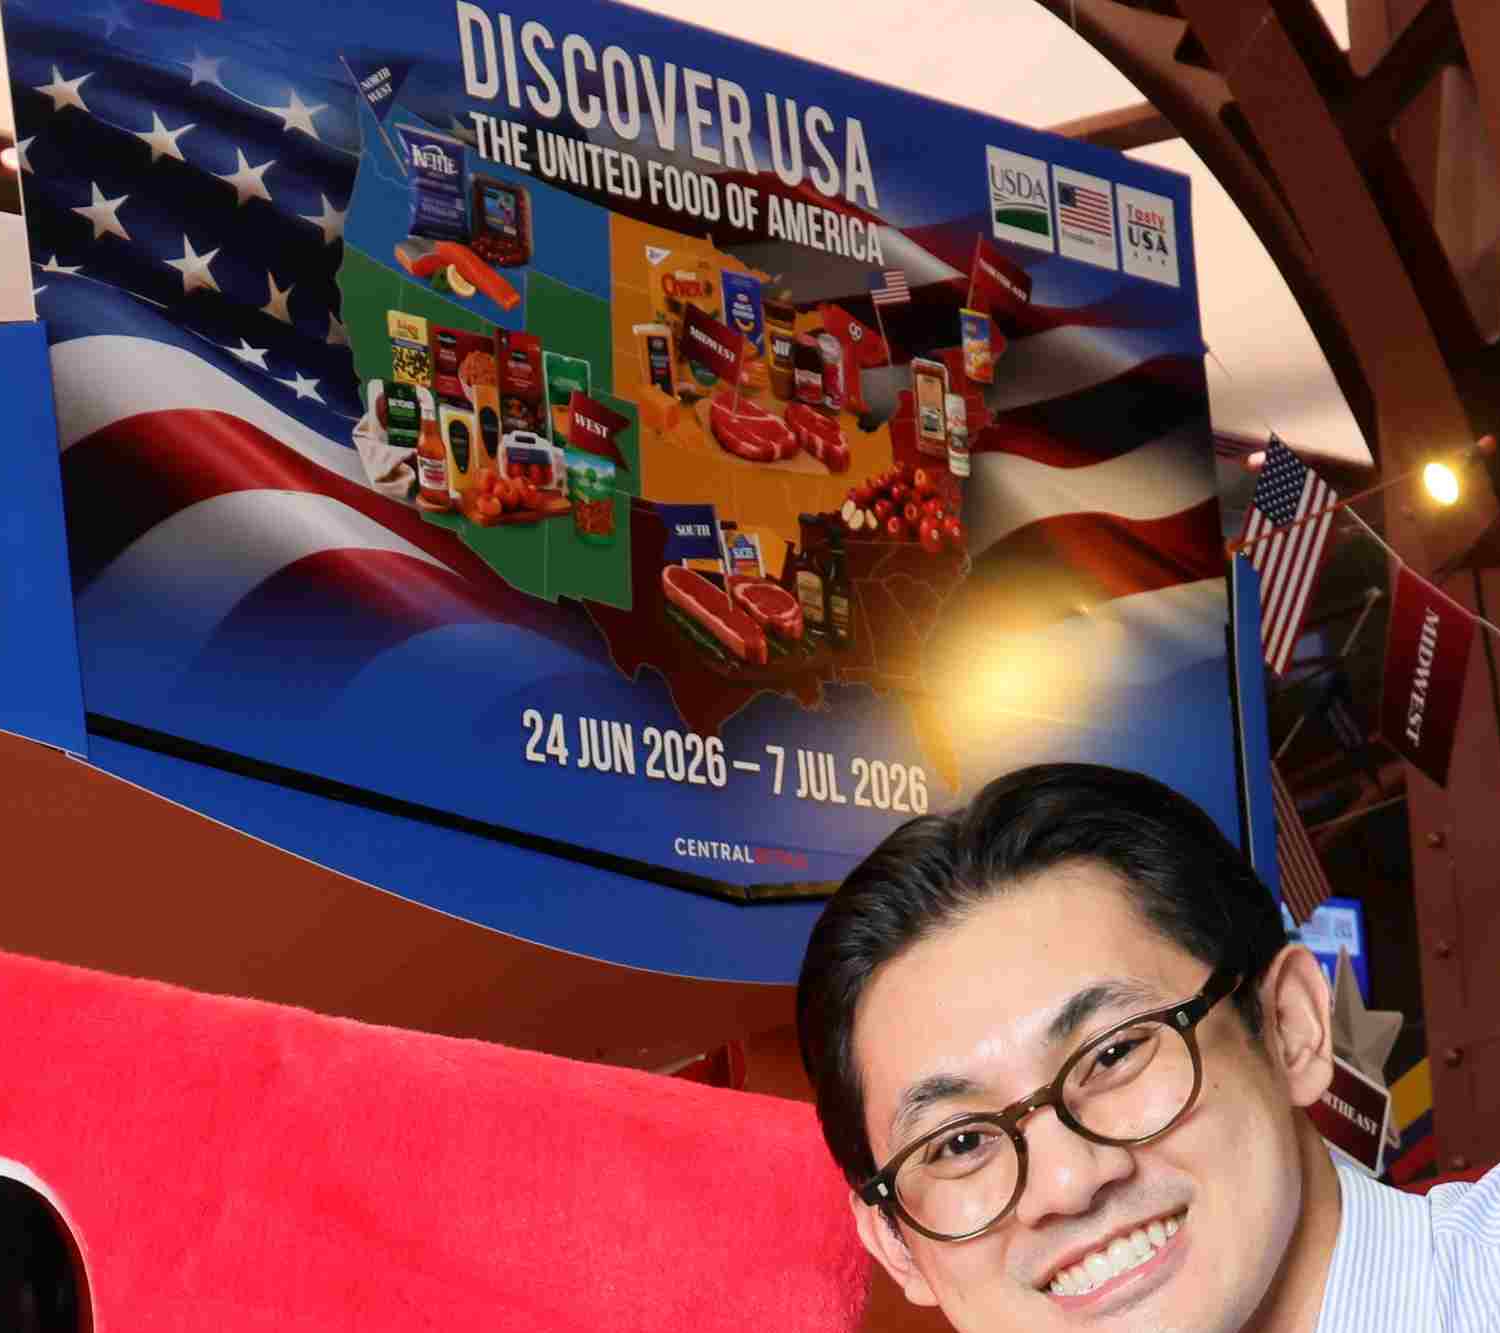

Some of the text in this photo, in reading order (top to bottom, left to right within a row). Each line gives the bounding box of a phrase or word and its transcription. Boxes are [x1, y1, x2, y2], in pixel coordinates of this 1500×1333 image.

[456, 0, 878, 209] DISCOVER USA
[470, 111, 885, 266] THE UNITED FOOD OF AMERICA
[991, 165, 1047, 203] USDA
[1128, 203, 1166, 232] Tasty
[1128, 227, 1168, 255] USA
[574, 412, 609, 439] WEST
[674, 522, 711, 537] SOUTH
[1404, 606, 1440, 747] MIDWEST
[522, 709, 928, 814] 24 JUN 2026 7 JUL 2026
